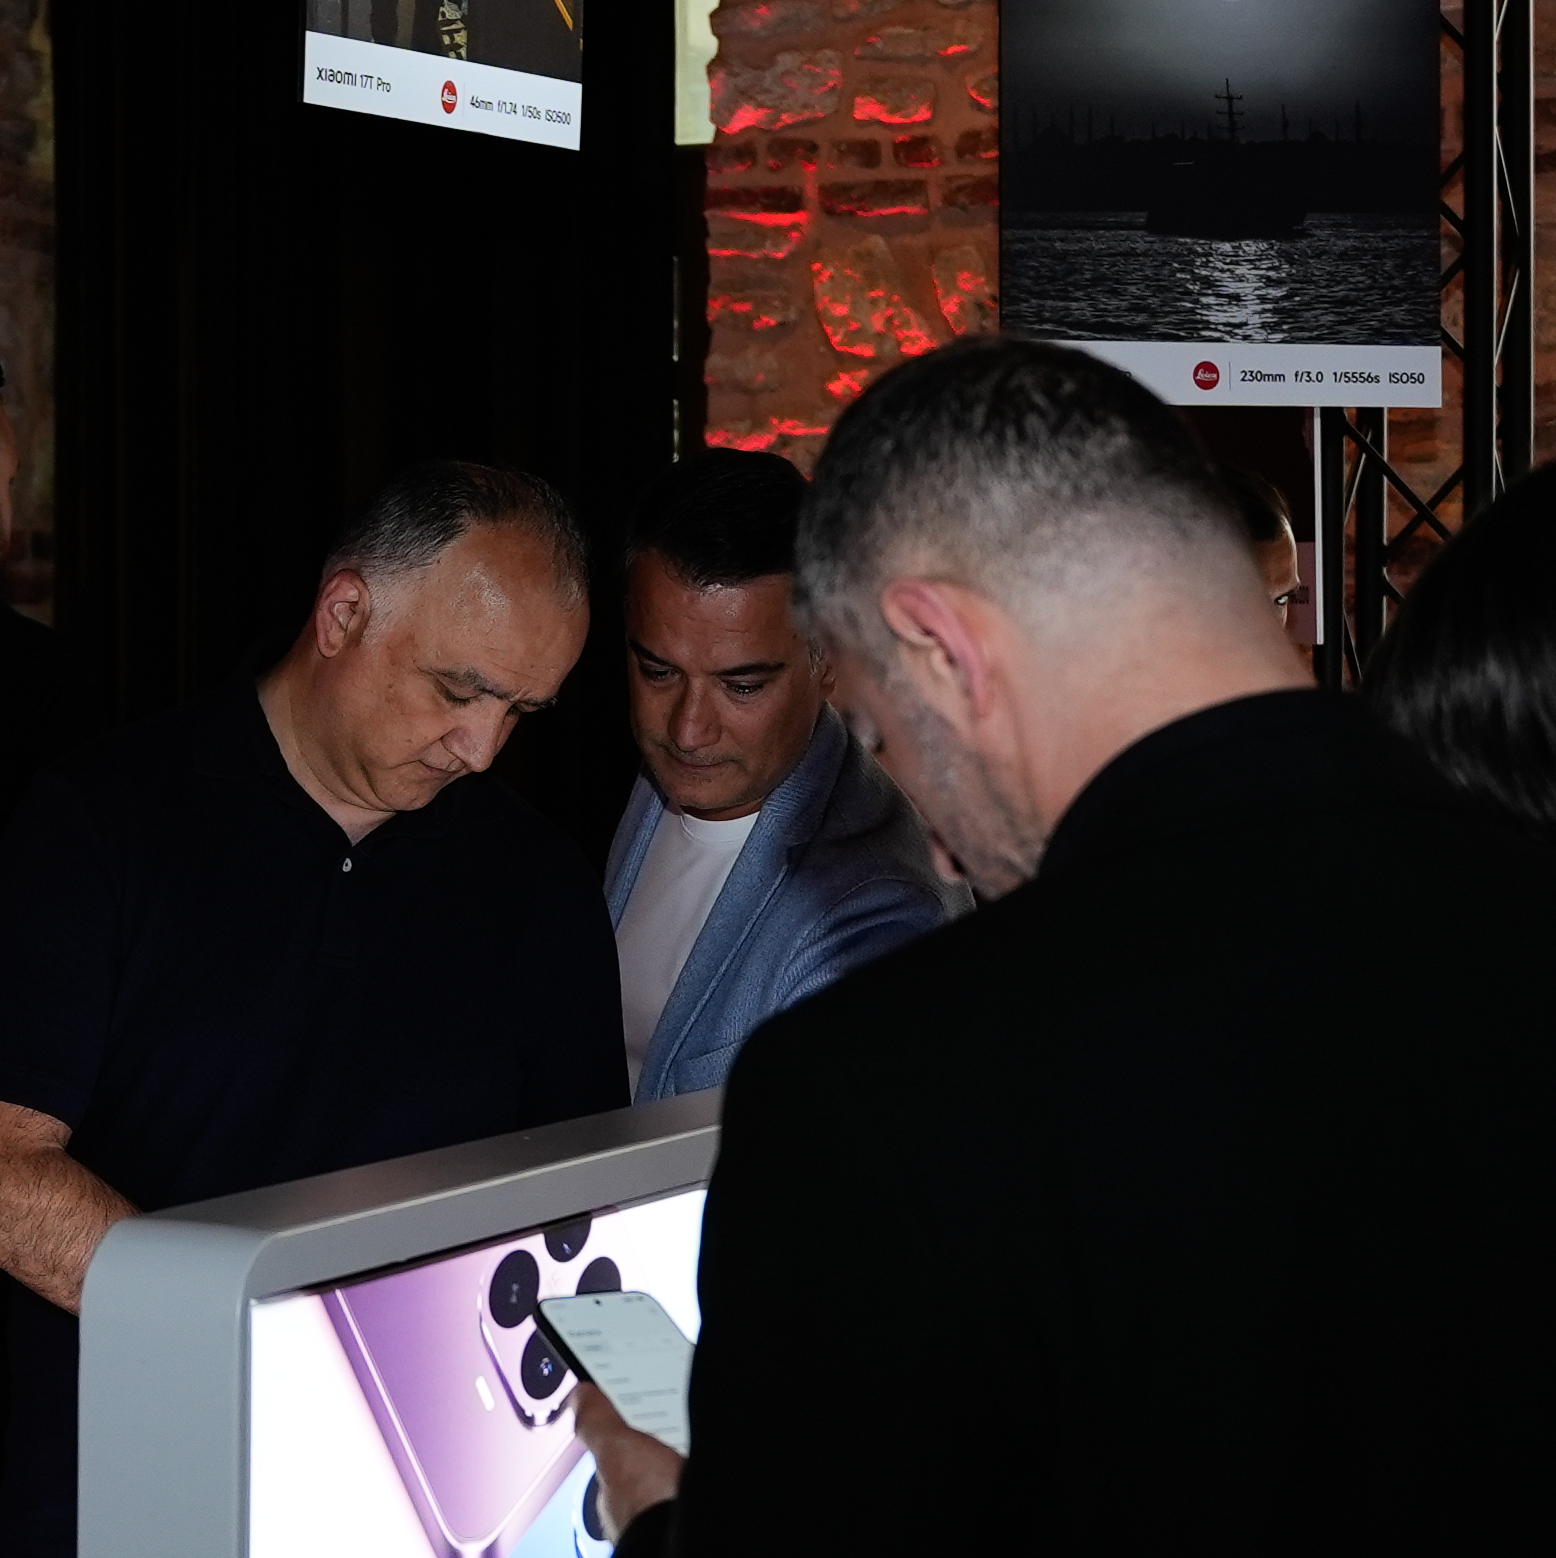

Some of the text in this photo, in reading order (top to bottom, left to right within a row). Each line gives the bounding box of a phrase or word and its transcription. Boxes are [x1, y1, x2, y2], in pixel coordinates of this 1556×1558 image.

[360, 74, 374, 90] 17T
[376, 77, 392, 94] Pro
[470, 95, 572, 126] 46mm f/1.74 1/50s ISO500
[1240, 370, 1426, 385] 230mm f/3.0 1/5556s ISO50
